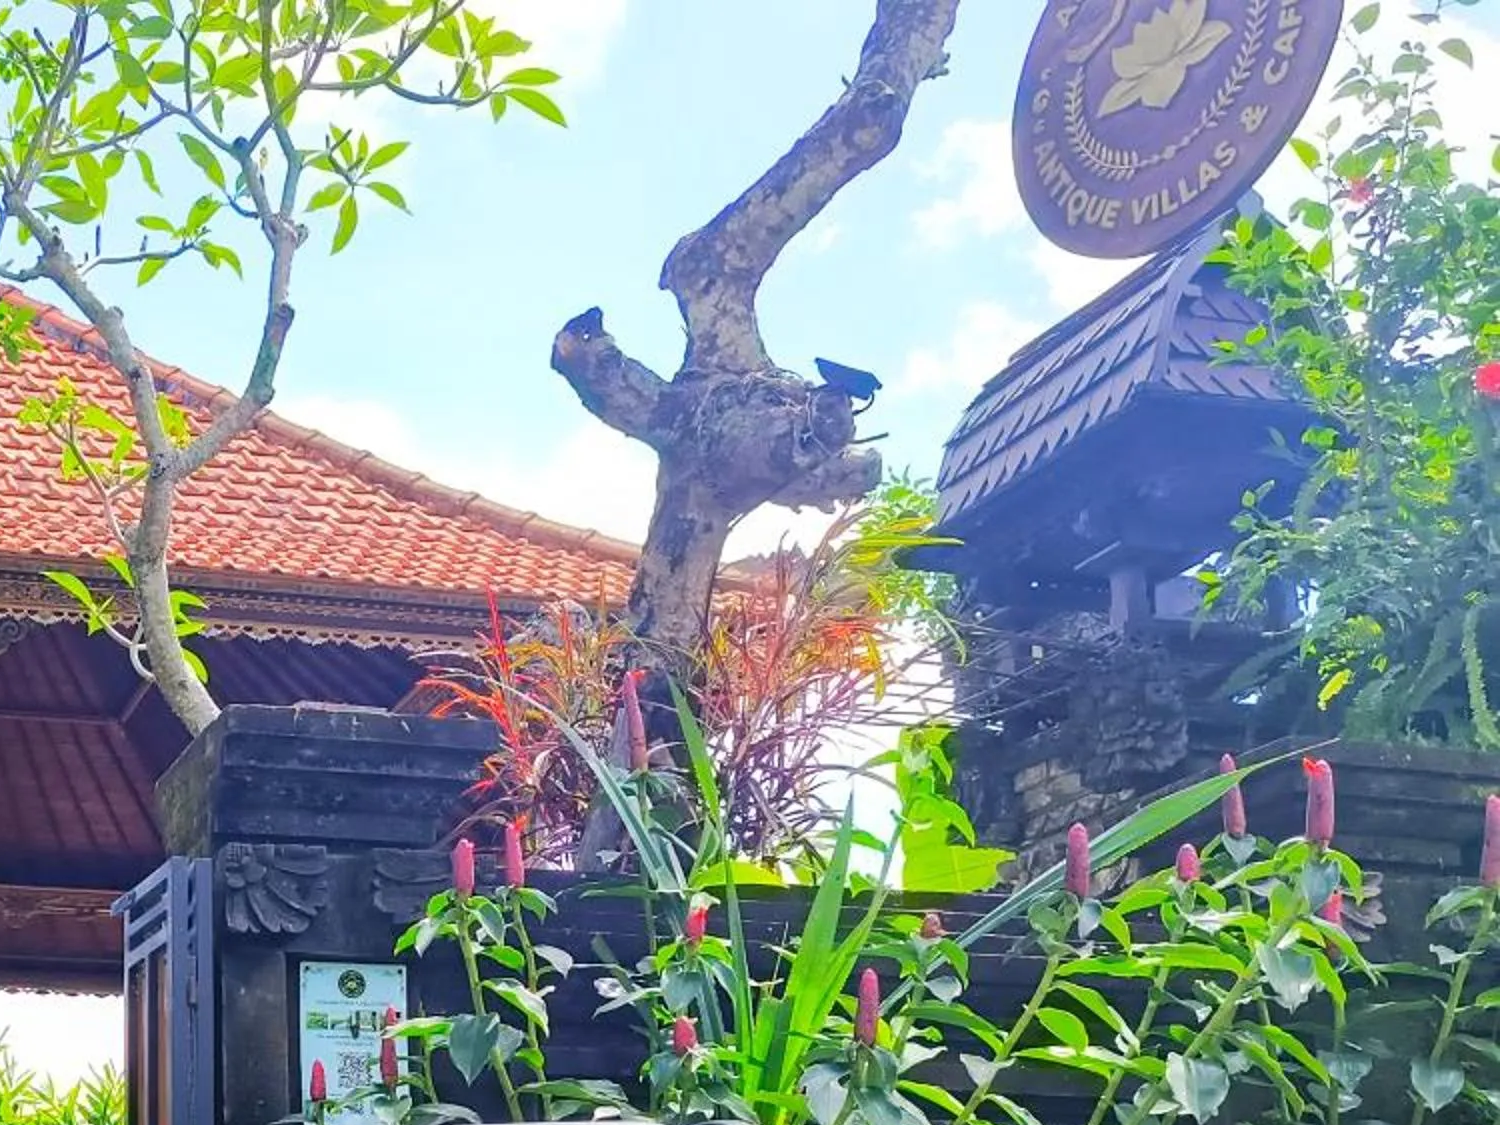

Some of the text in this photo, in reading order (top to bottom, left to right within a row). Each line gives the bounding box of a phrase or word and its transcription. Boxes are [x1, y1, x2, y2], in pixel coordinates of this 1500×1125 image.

[1033, 140, 1123, 228] ANTIQUE
[1131, 140, 1237, 225] VILLAS
[1239, 103, 1269, 132] &
